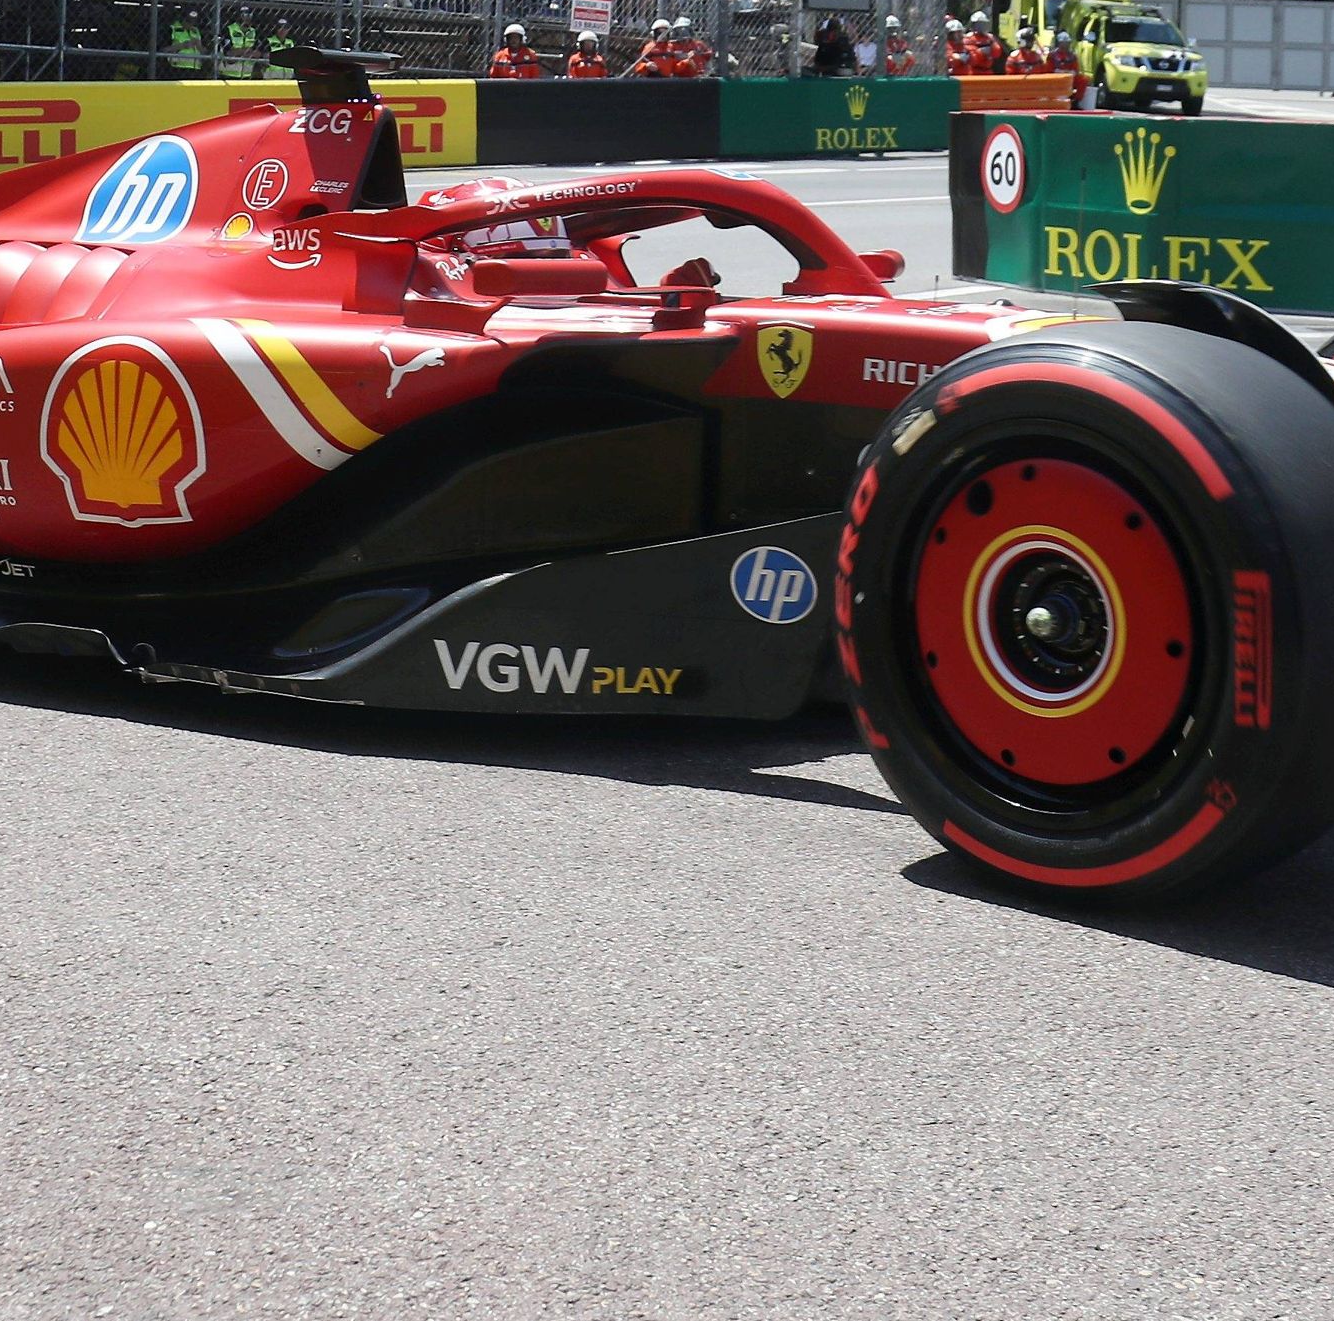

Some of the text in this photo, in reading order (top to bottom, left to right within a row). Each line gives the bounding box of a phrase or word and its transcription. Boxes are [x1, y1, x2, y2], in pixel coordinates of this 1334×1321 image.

[816, 127, 898, 150] ROLEX
[87, 139, 188, 241] hp
[534, 182, 636, 202] TECHNOLOGY
[990, 151, 1016, 187] 60
[272, 228, 321, 252] aws
[1044, 226, 1274, 291] ROLEX
[744, 547, 807, 622] hp
[433, 638, 683, 695] VGW PLAY
